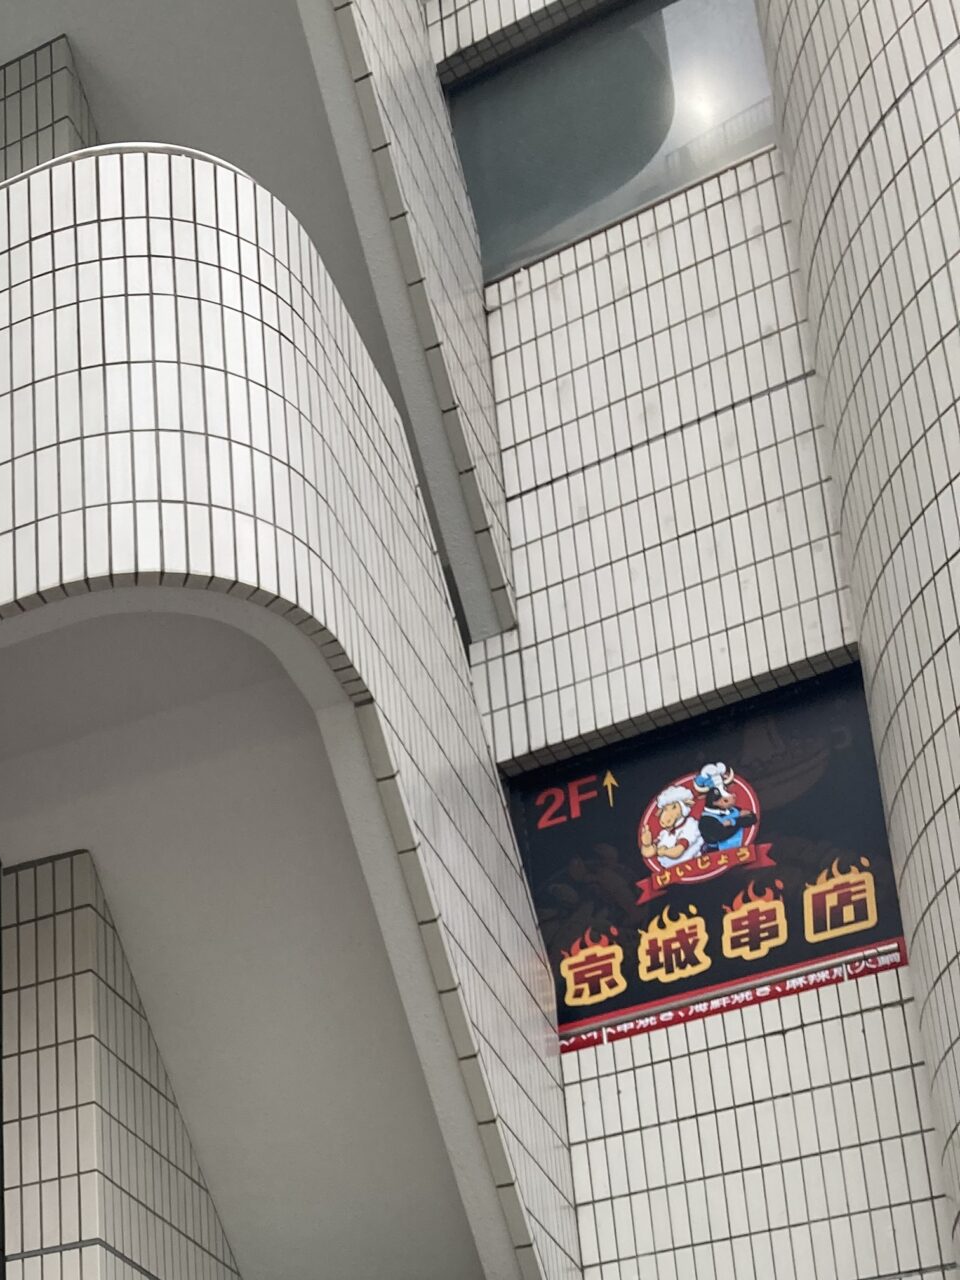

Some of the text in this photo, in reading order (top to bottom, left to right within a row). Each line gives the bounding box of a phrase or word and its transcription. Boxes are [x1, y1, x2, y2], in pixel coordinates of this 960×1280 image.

[534, 775, 598, 830] 2F
[656, 846, 751, 887] けいじょう
[560, 867, 878, 1007] 京城串店
